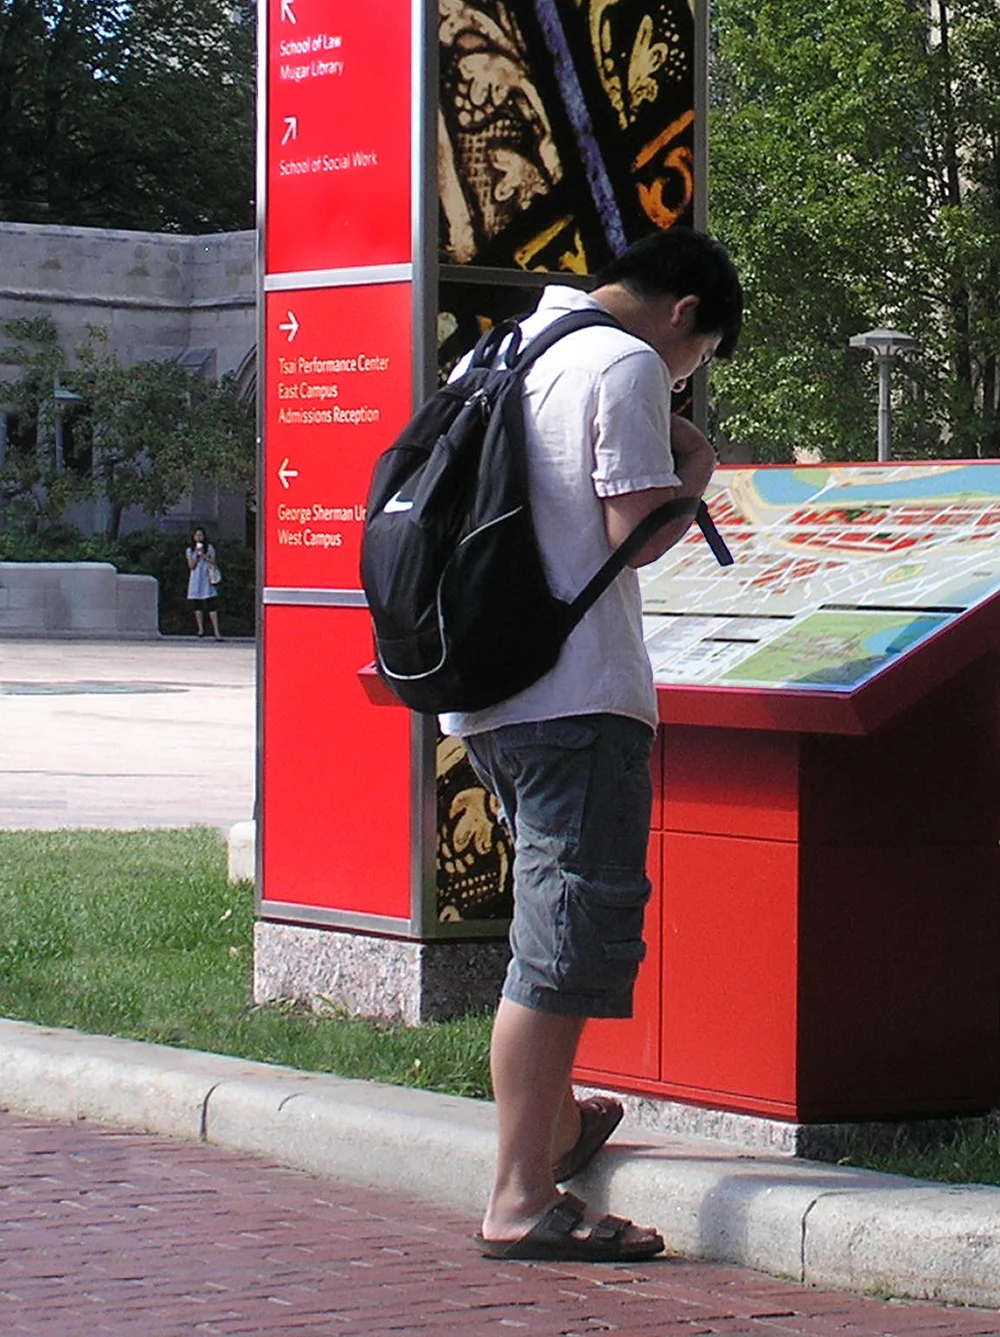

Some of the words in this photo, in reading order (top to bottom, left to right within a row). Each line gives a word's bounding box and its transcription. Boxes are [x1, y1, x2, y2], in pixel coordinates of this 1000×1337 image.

[280, 35, 310, 56] School
[312, 34, 322, 51] of
[323, 34, 342, 50] Law
[280, 64, 310, 82] Mugar
[311, 60, 344, 77] Library
[280, 158, 310, 176] School
[311, 156, 321, 173] of
[322, 152, 350, 171] Social
[352, 149, 378, 167] Work
[279, 357, 297, 375] Tsai
[298, 356, 357, 373] Performance
[358, 354, 390, 371] Center
[278, 383, 299, 399] East
[300, 382, 338, 401] Campus
[278, 407, 332, 424] Admissions
[333, 405, 380, 425] Reception
[278, 504, 312, 524] George
[312, 504, 353, 521] Sherman
[278, 530, 302, 545] West
[303, 529, 342, 549] Campus
